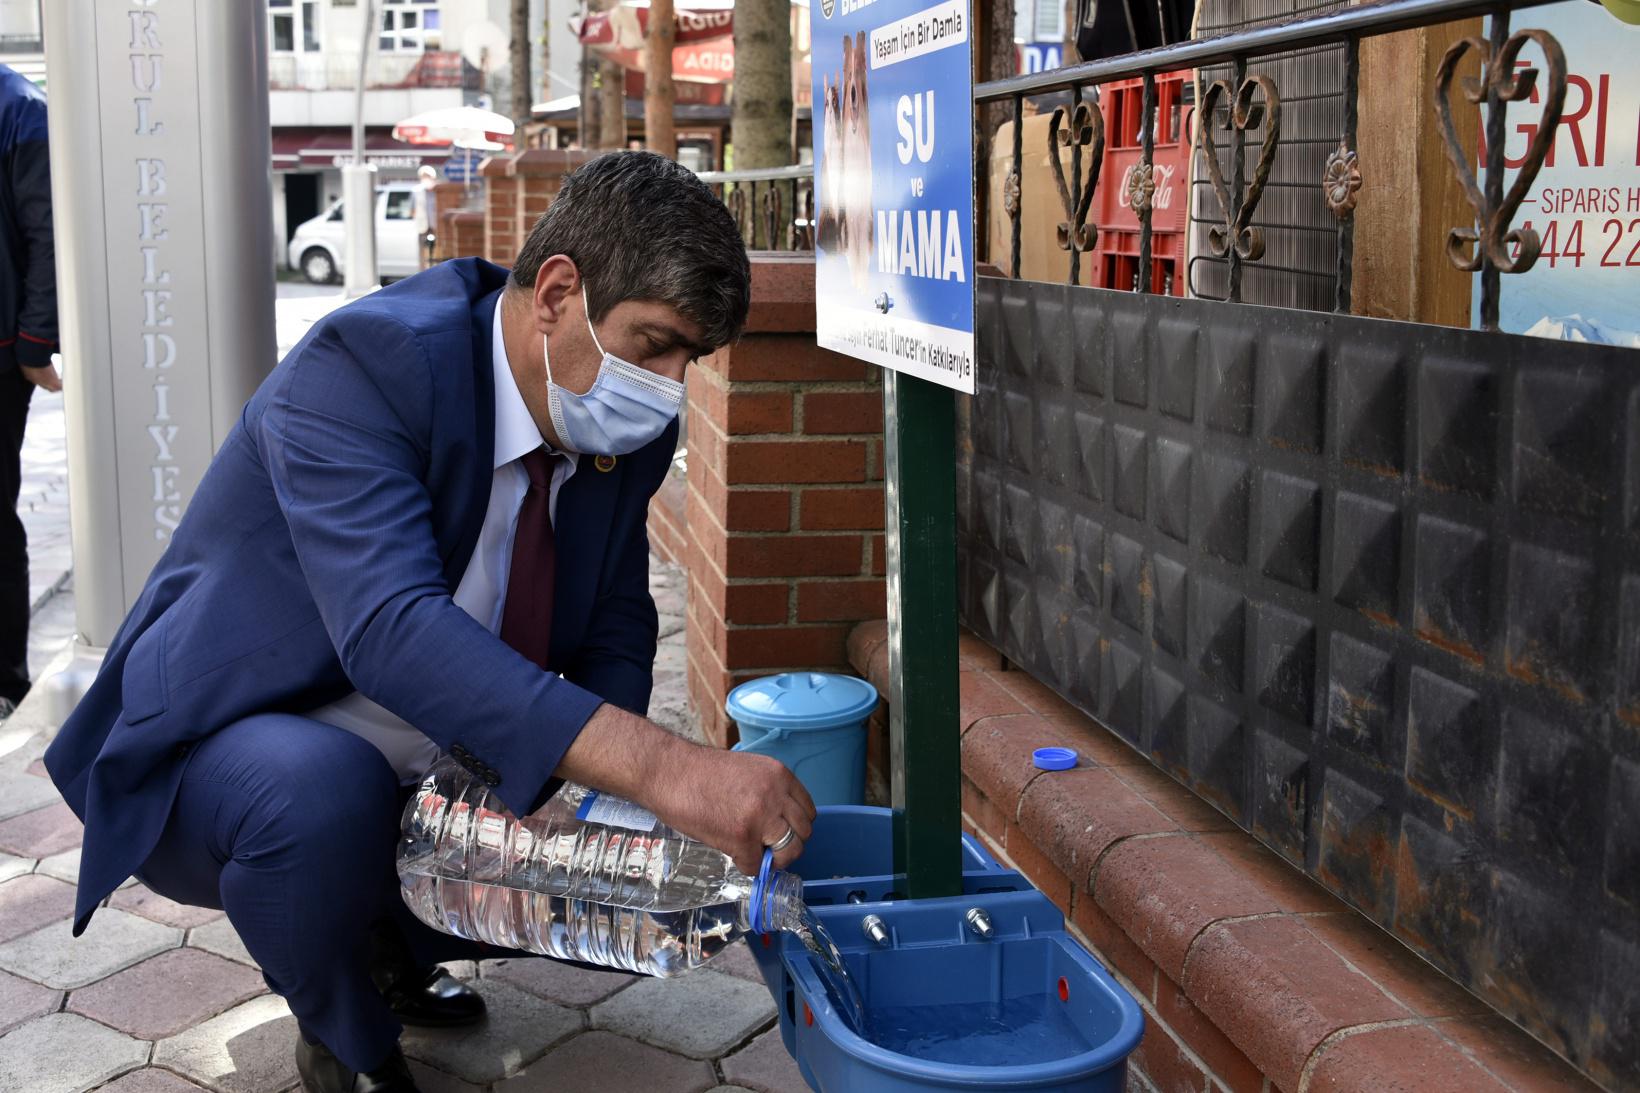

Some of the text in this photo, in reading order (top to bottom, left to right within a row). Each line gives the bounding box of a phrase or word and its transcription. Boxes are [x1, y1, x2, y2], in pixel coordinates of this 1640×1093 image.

[873, 10, 962, 60] Yaşam İçin Bir Damla
[896, 90, 935, 165] SU
[911, 176, 924, 198] ve
[877, 209, 966, 283] MAMA
[928, 343, 971, 379] Katkılarıyla
